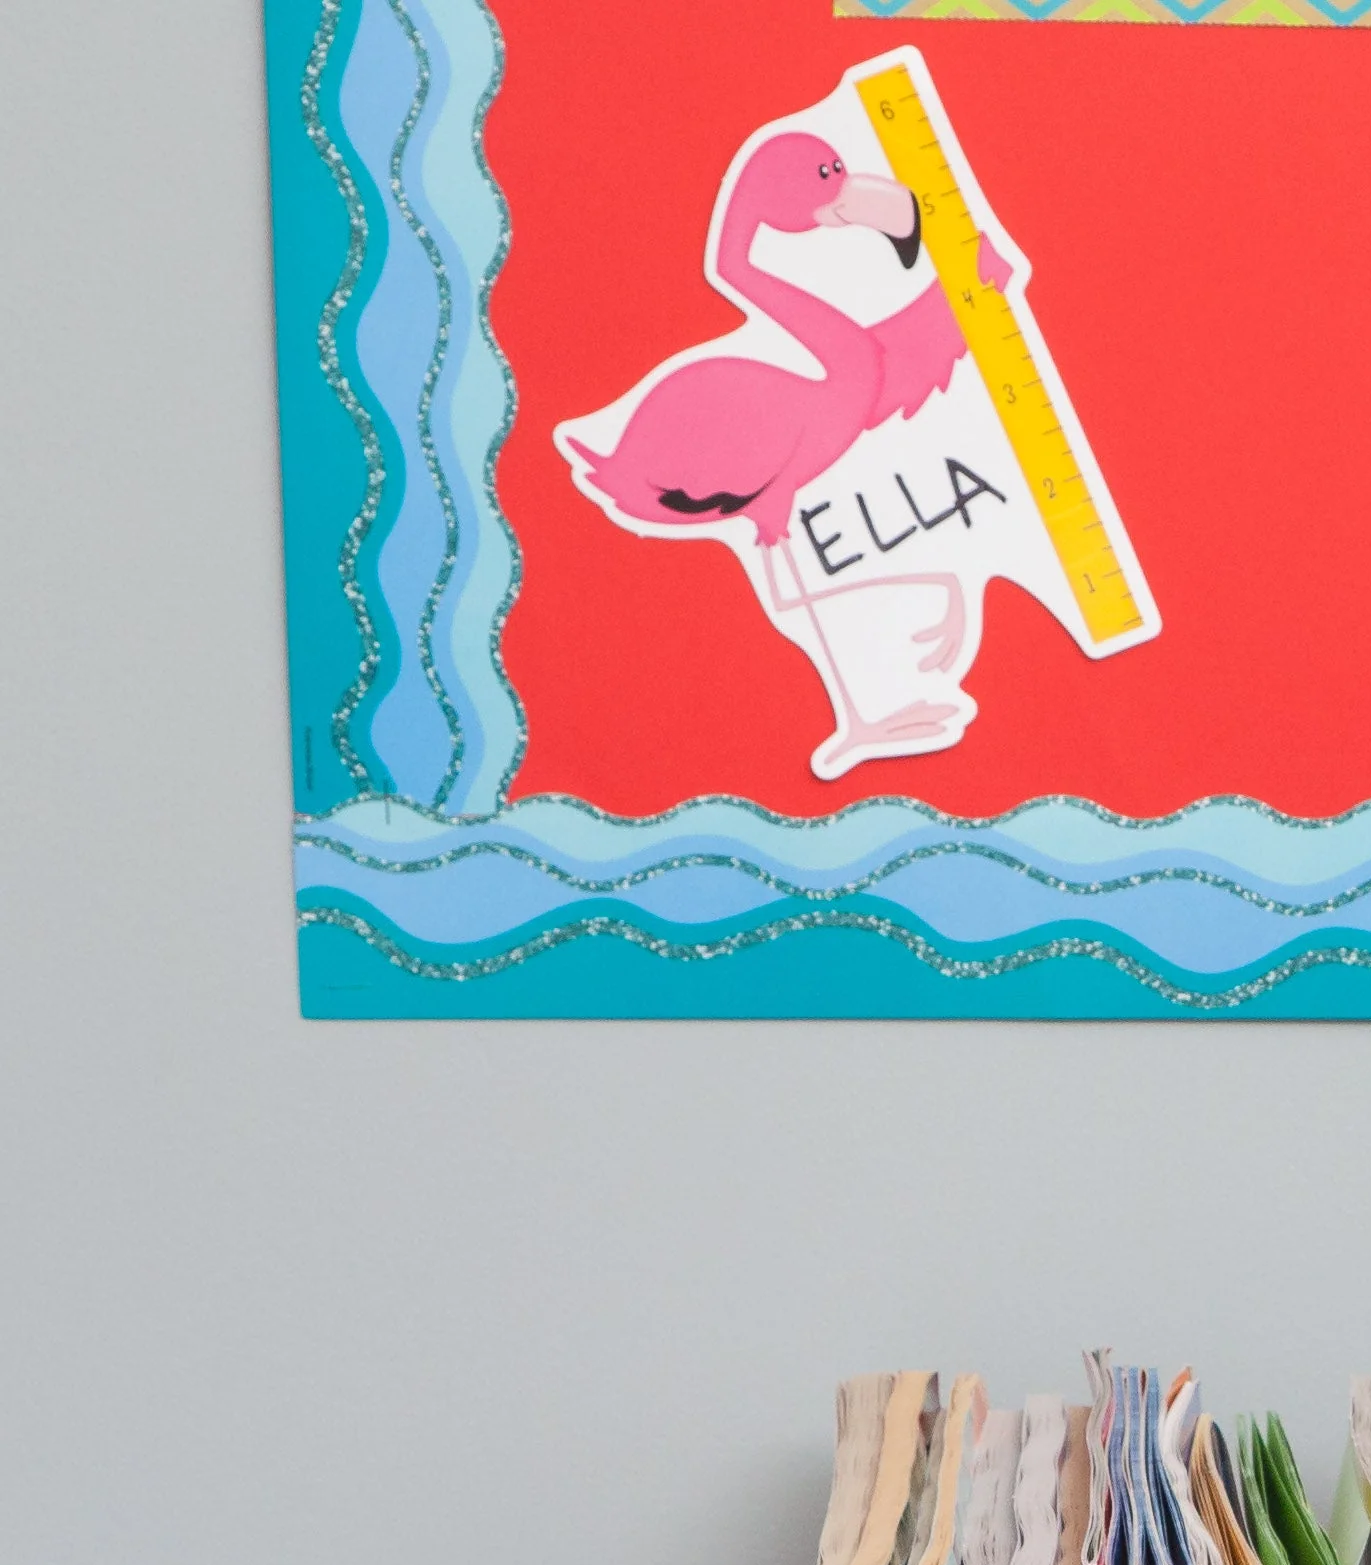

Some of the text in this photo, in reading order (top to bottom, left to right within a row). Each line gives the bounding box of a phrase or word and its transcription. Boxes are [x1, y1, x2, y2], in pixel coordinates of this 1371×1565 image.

[880, 99, 896, 121] 6
[921, 194, 936, 216] 5
[962, 290, 976, 310] 4
[1002, 384, 1017, 405] 3
[1042, 478, 1057, 499] 2
[800, 457, 1007, 576] ELLA
[1083, 573, 1097, 594] 1
